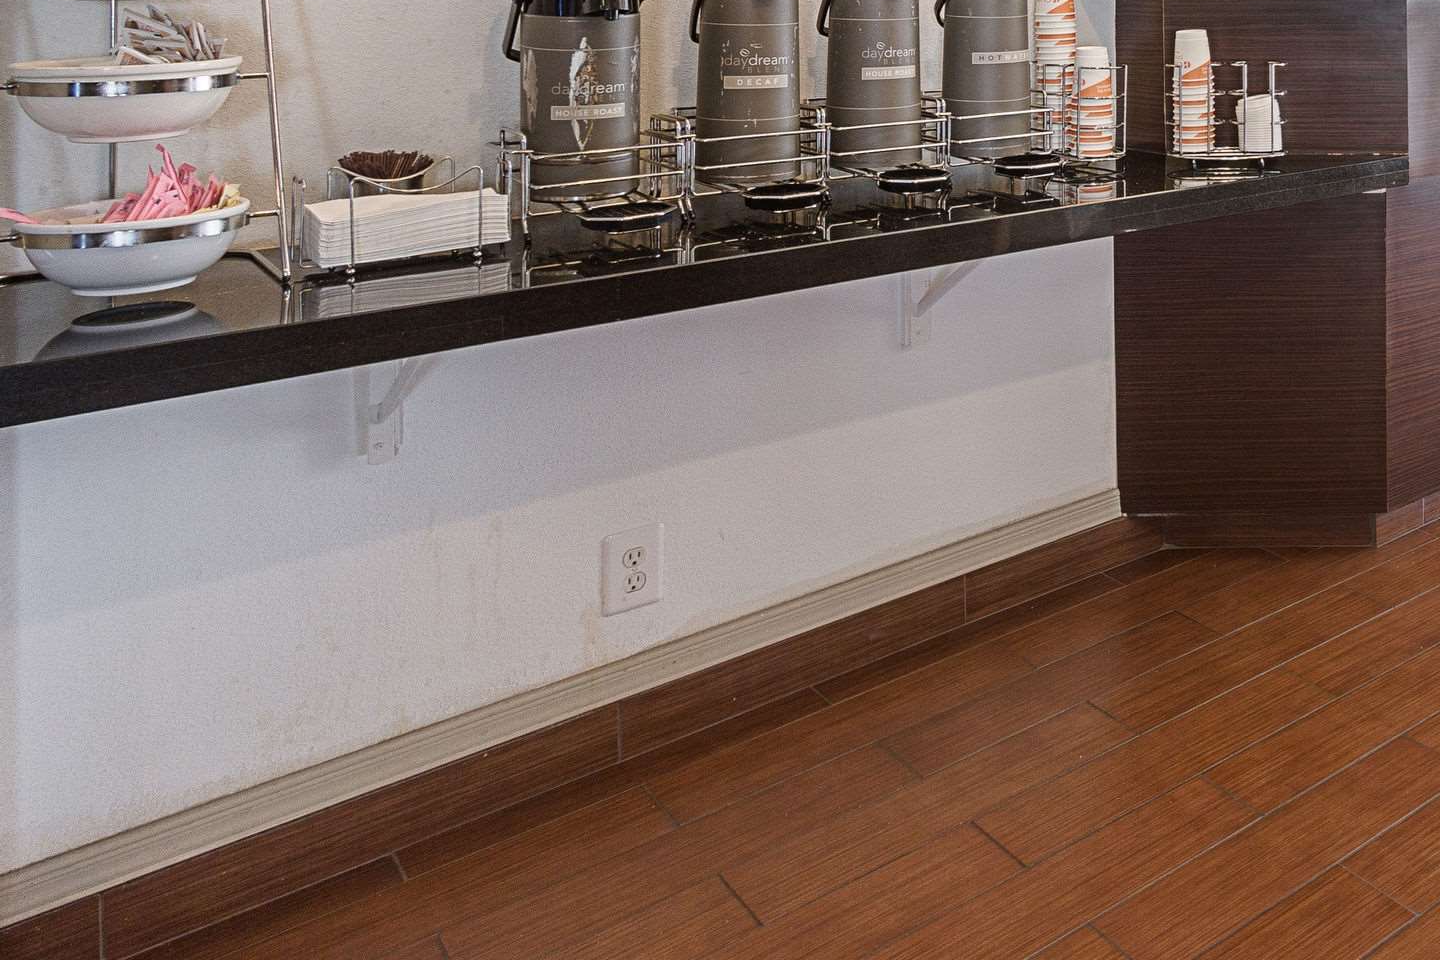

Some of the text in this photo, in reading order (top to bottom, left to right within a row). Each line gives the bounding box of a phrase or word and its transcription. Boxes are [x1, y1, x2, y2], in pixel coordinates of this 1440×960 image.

[862, 46, 916, 61] daydream
[724, 53, 788, 70] daydream
[551, 81, 625, 96] dadream
[737, 78, 778, 86] DECAF
